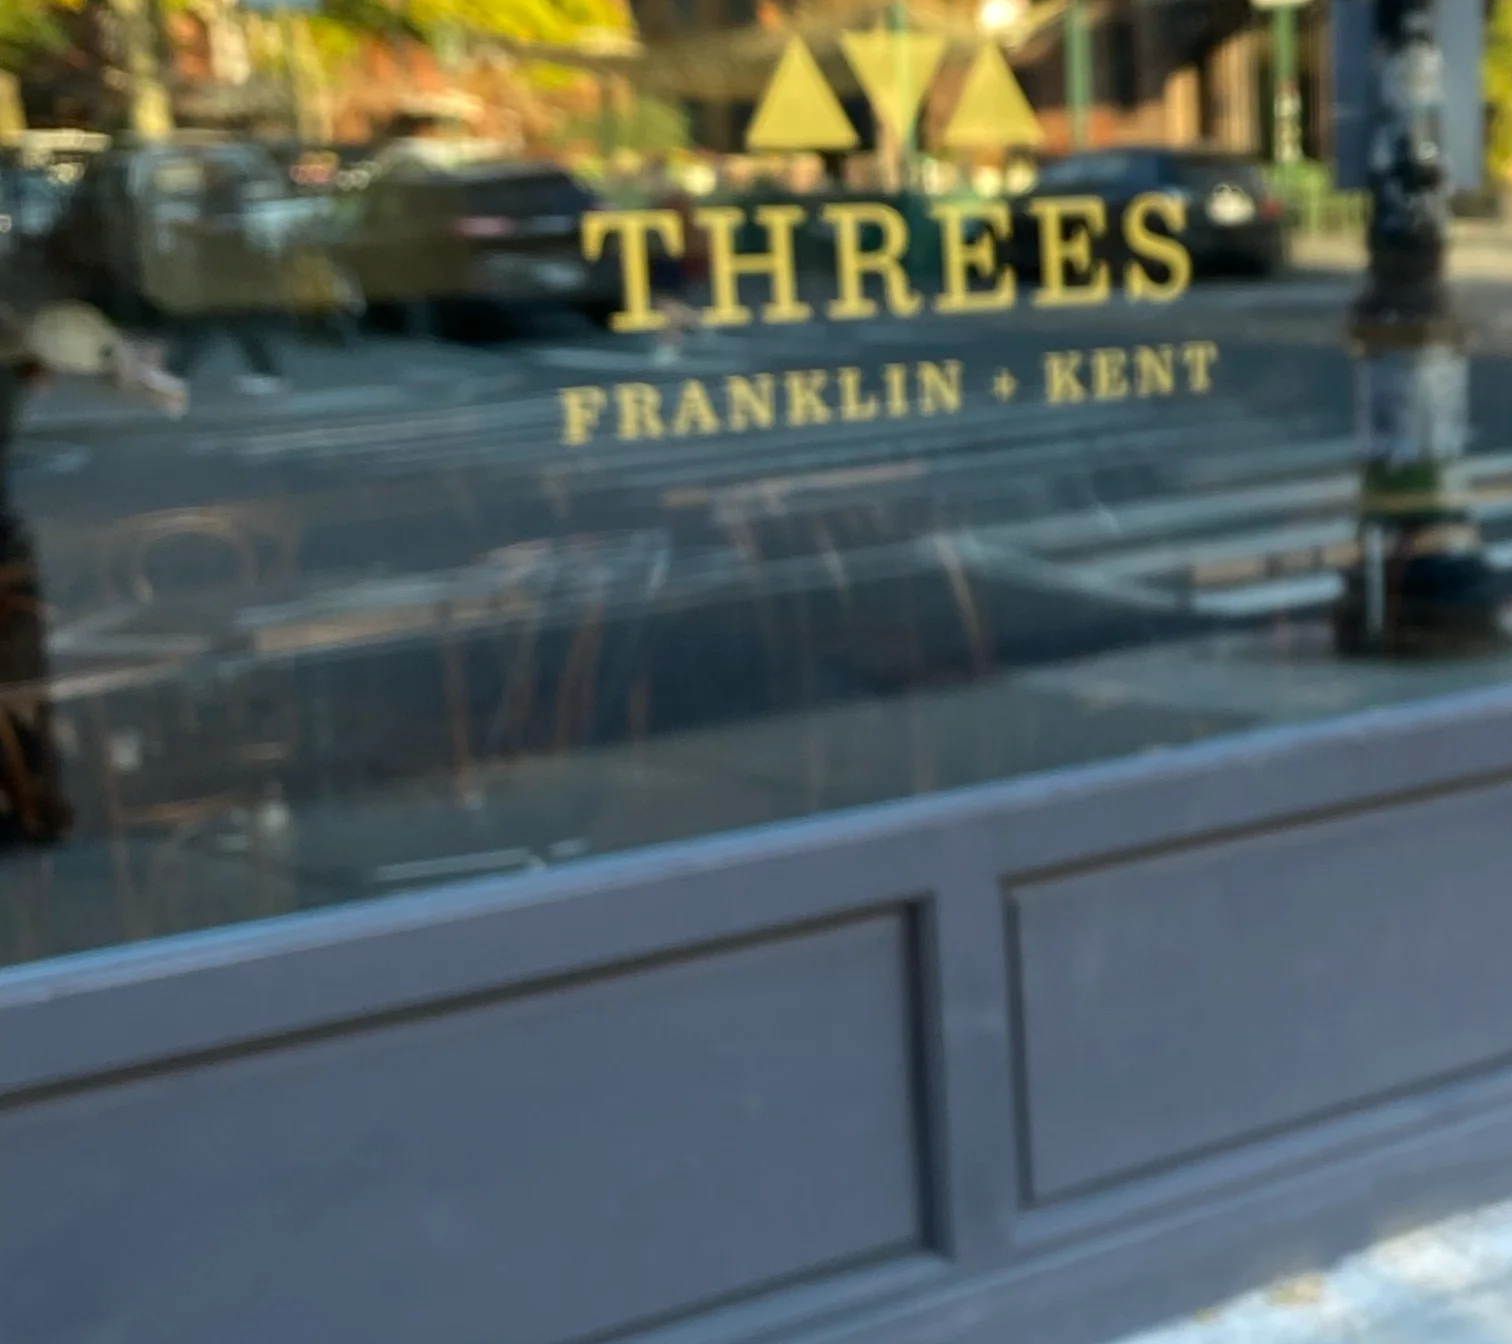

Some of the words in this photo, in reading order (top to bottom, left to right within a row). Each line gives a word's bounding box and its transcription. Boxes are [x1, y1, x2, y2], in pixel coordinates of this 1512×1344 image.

[582, 193, 1194, 334] THREES
[561, 361, 964, 445] FRANKLIN
[1044, 341, 1219, 406] KENT
